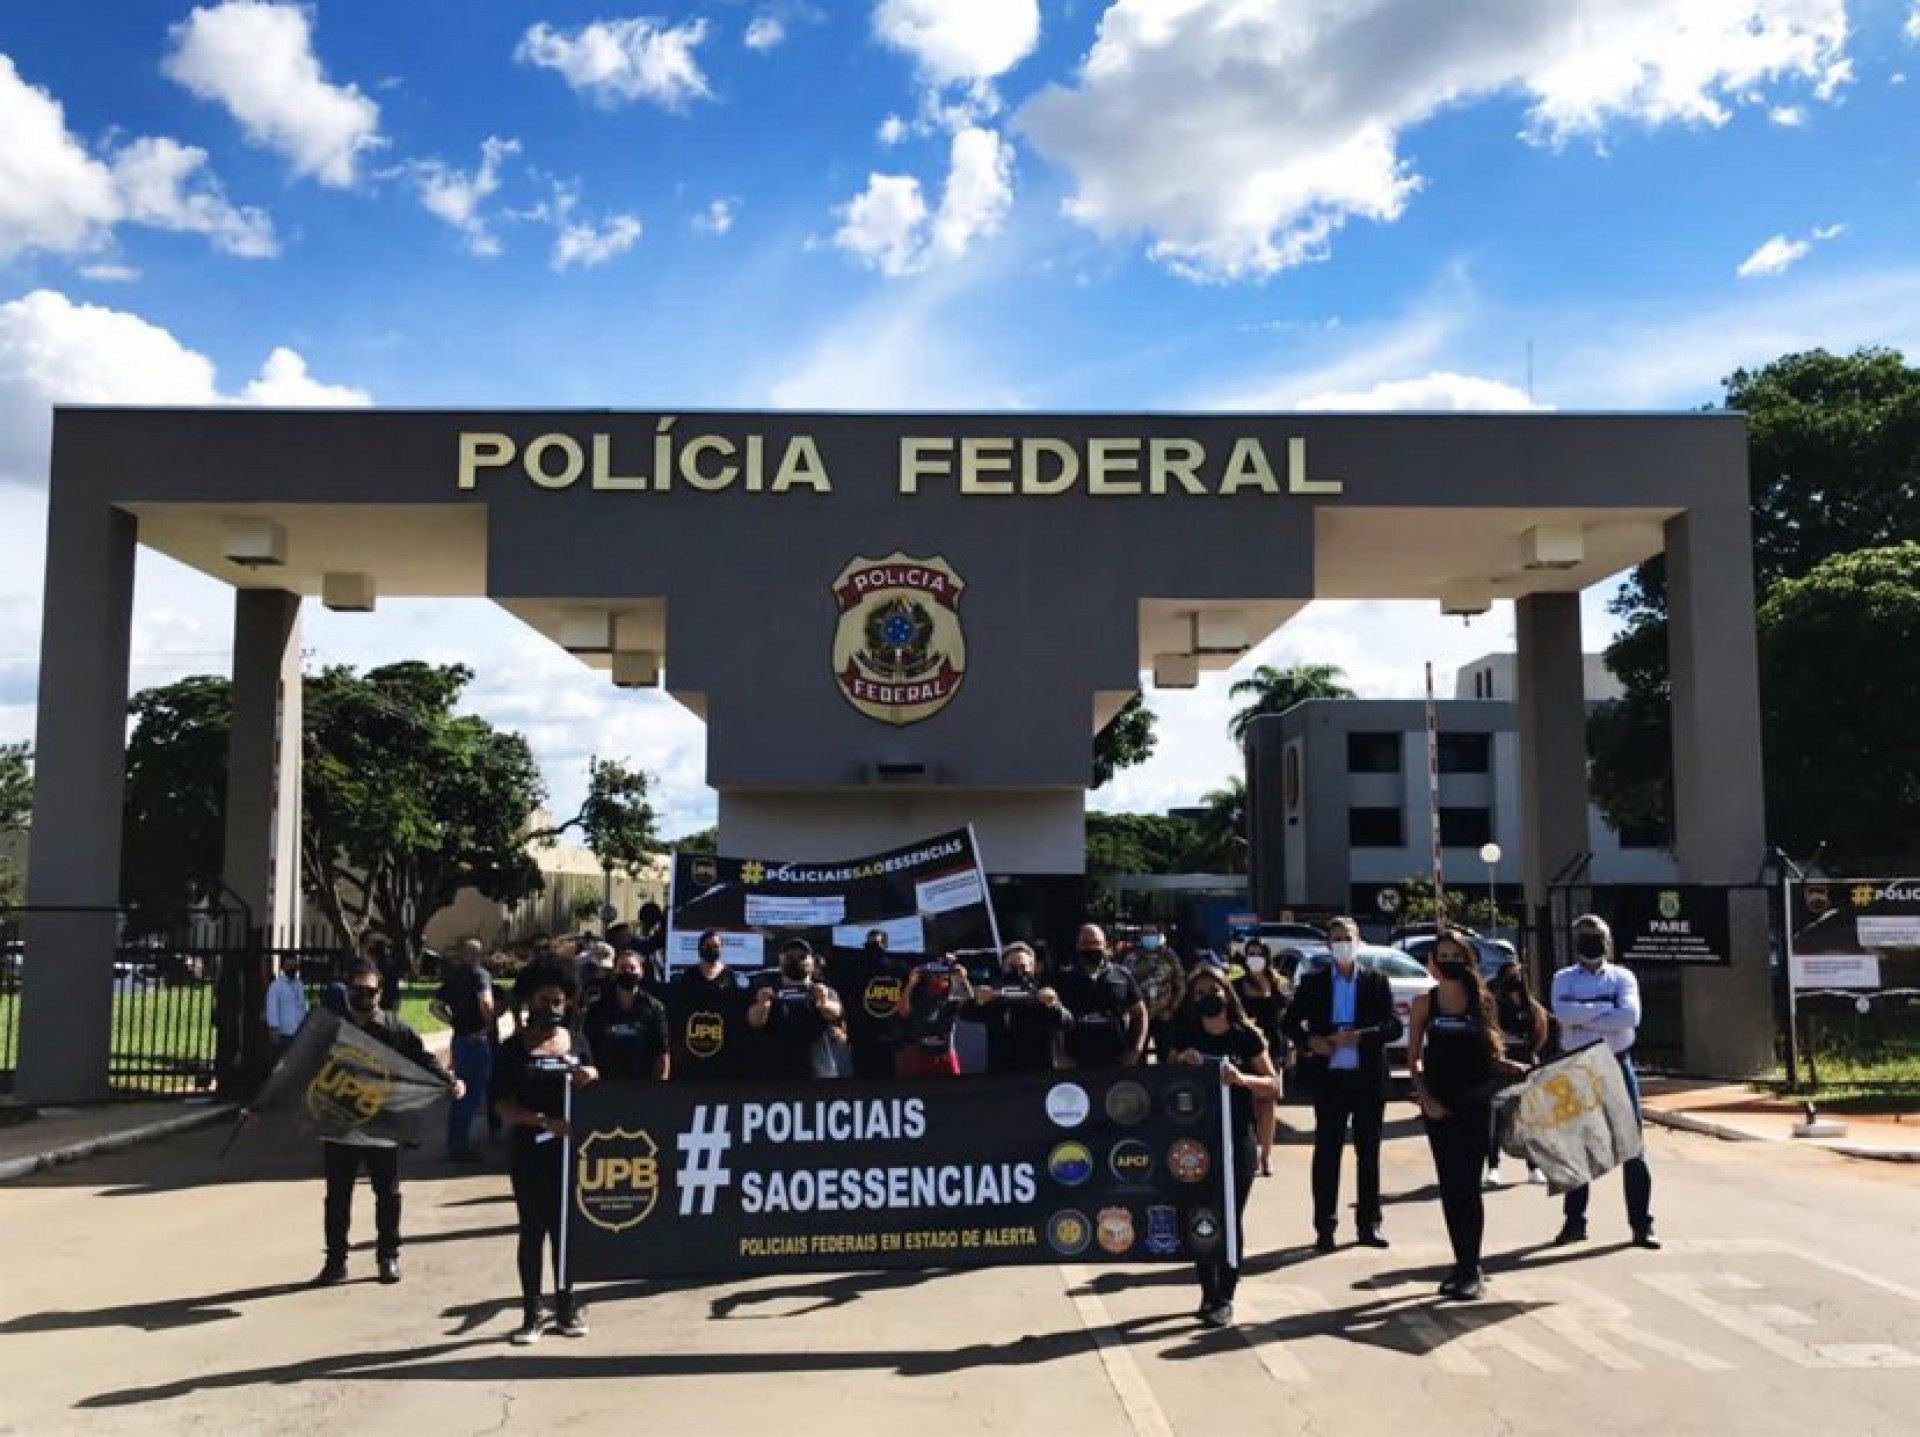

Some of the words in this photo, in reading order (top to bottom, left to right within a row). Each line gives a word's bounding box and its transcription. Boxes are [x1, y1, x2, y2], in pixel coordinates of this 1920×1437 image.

[457, 416, 832, 493] POLÍCIA
[900, 437, 1343, 495] FEDERAL
[854, 678, 945, 702] FEDERAL
[1649, 919, 1691, 933] PARE
[742, 1098, 926, 1143] POLICIAIS
[578, 1158, 659, 1190] UPB
[741, 1162, 1037, 1213] SAOESSENCIAIS
[740, 1236, 808, 1256] POLICIAIS
[811, 1232, 877, 1254] FEDERAIS
[880, 1231, 901, 1250] EM
[904, 1230, 958, 1249] ESTADO
[961, 1228, 980, 1247] DE
[983, 1226, 1037, 1246] ALERTA
